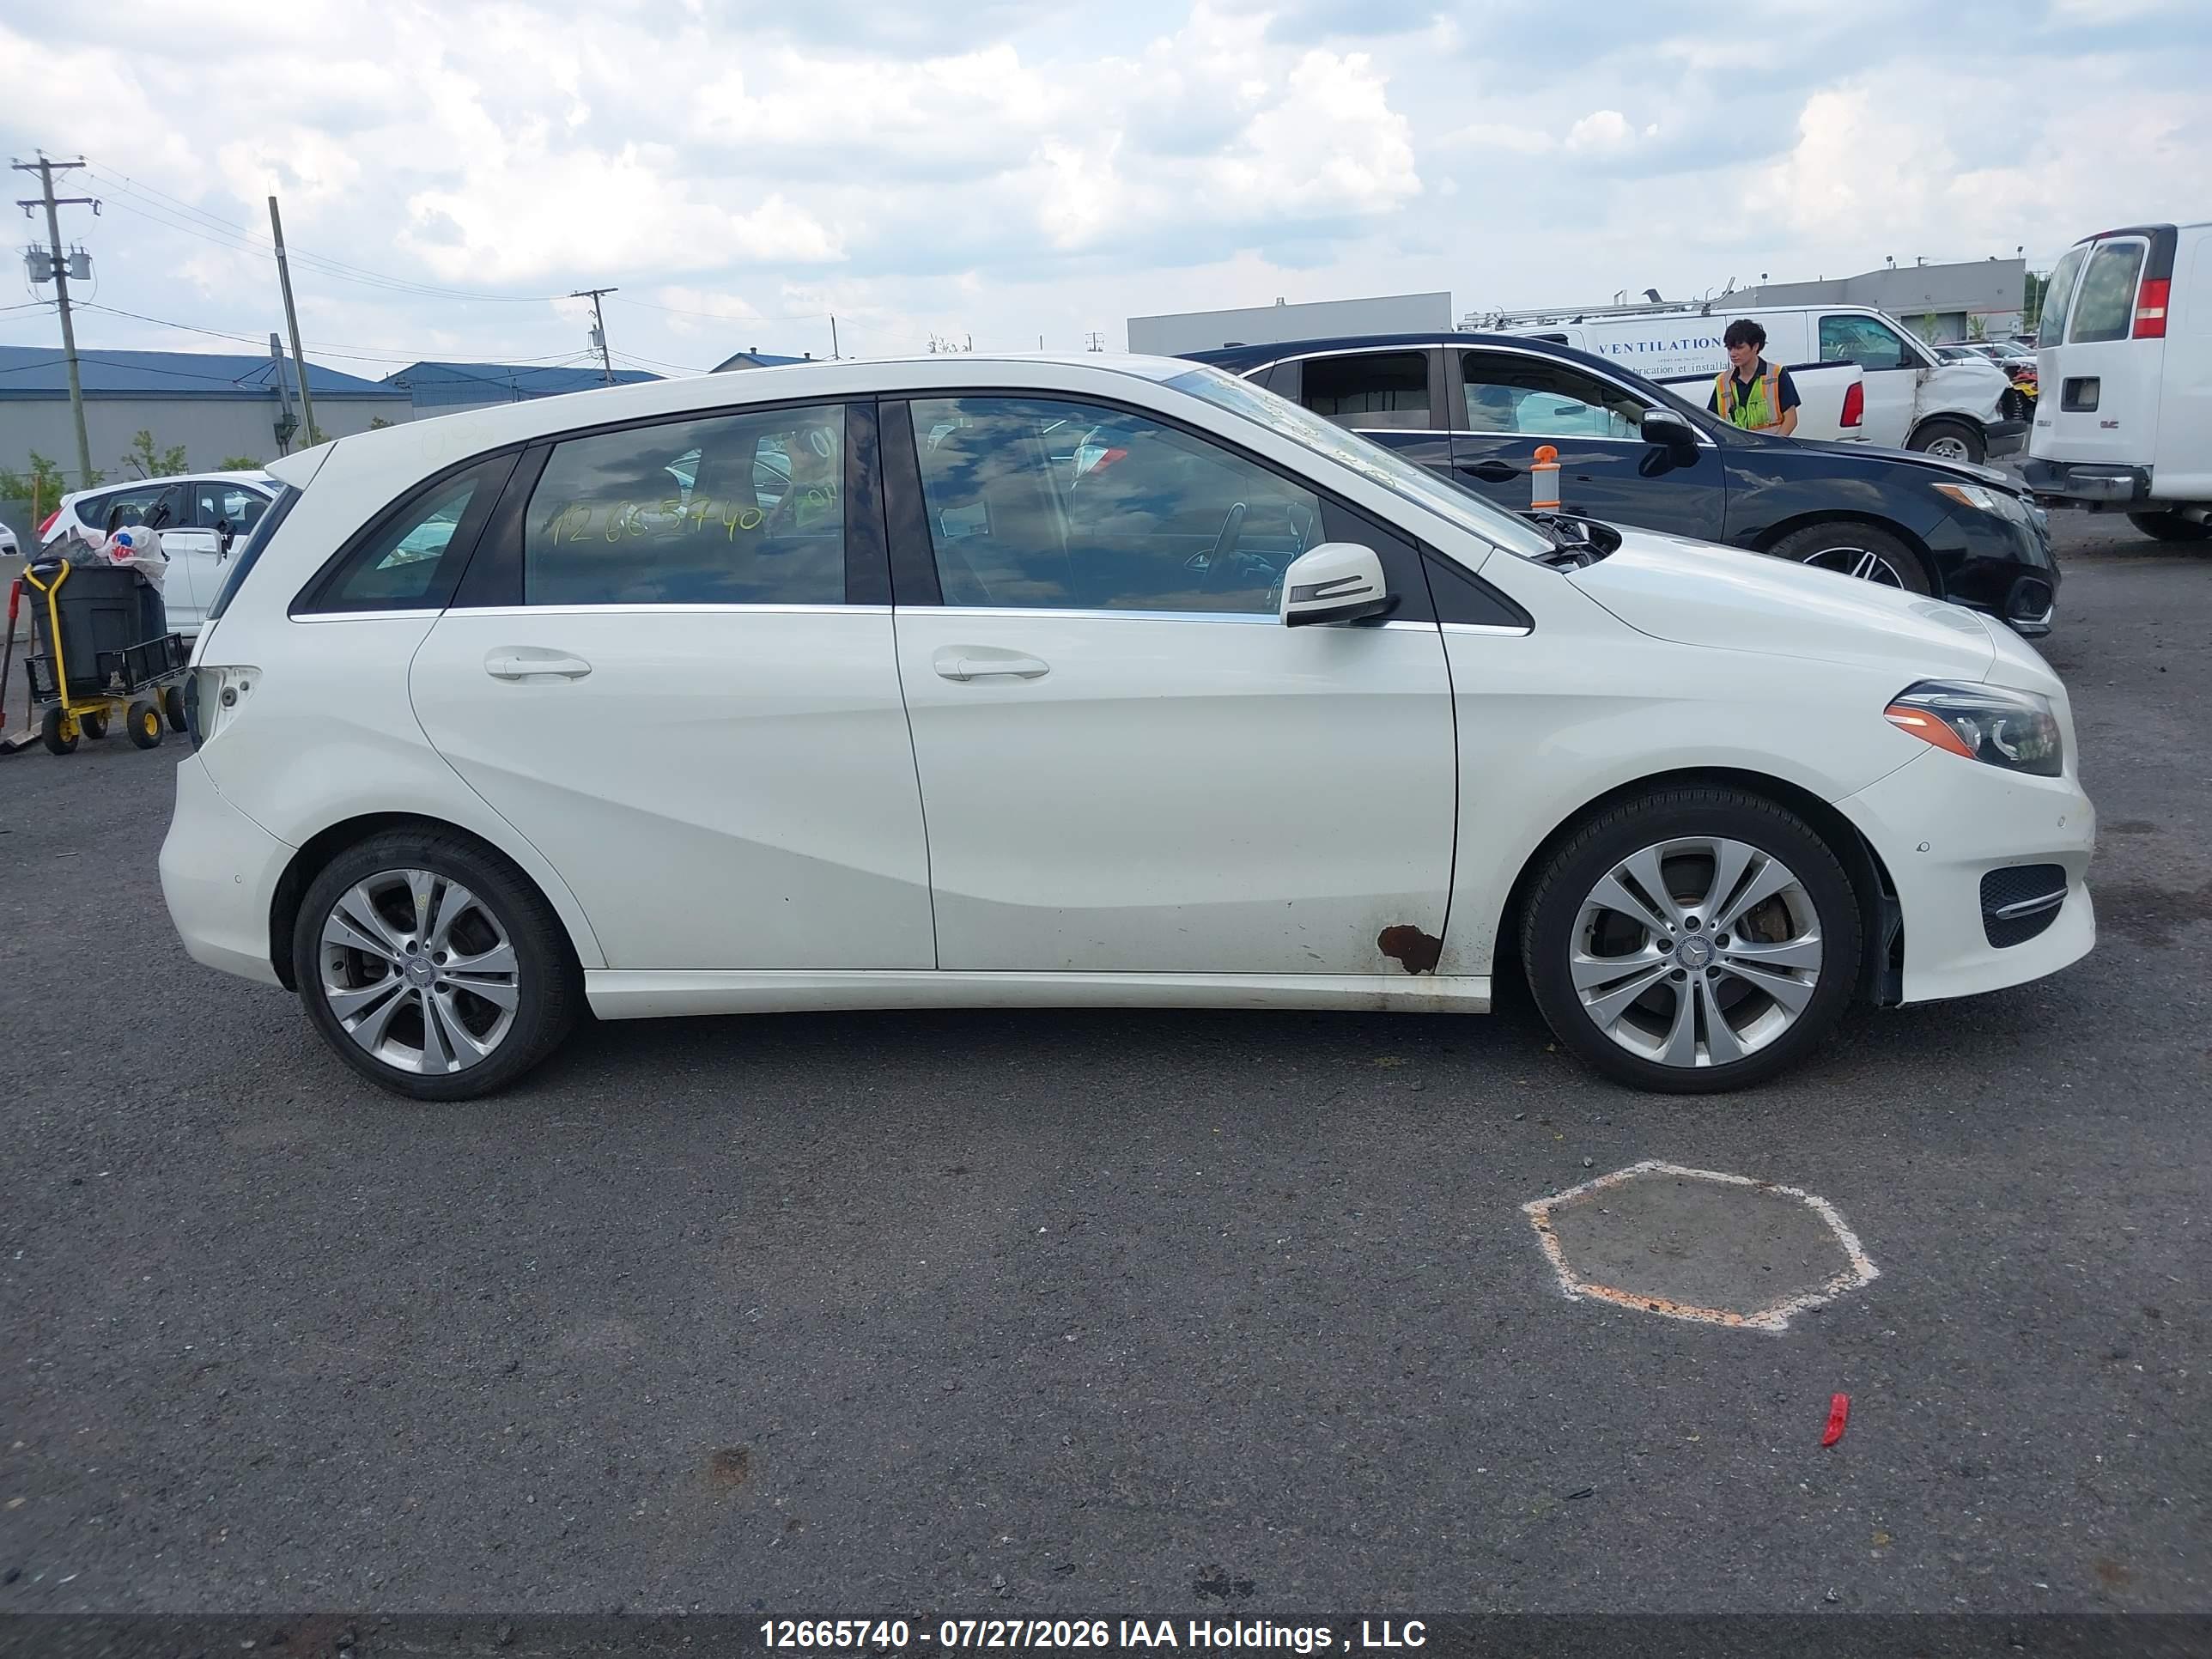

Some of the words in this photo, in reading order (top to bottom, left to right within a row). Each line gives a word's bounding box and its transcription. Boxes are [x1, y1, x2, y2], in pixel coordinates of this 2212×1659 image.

[1599, 337, 1722, 355] VENTILATION
[1632, 364, 1674, 376] brication
[555, 495, 764, 546] 12665740
